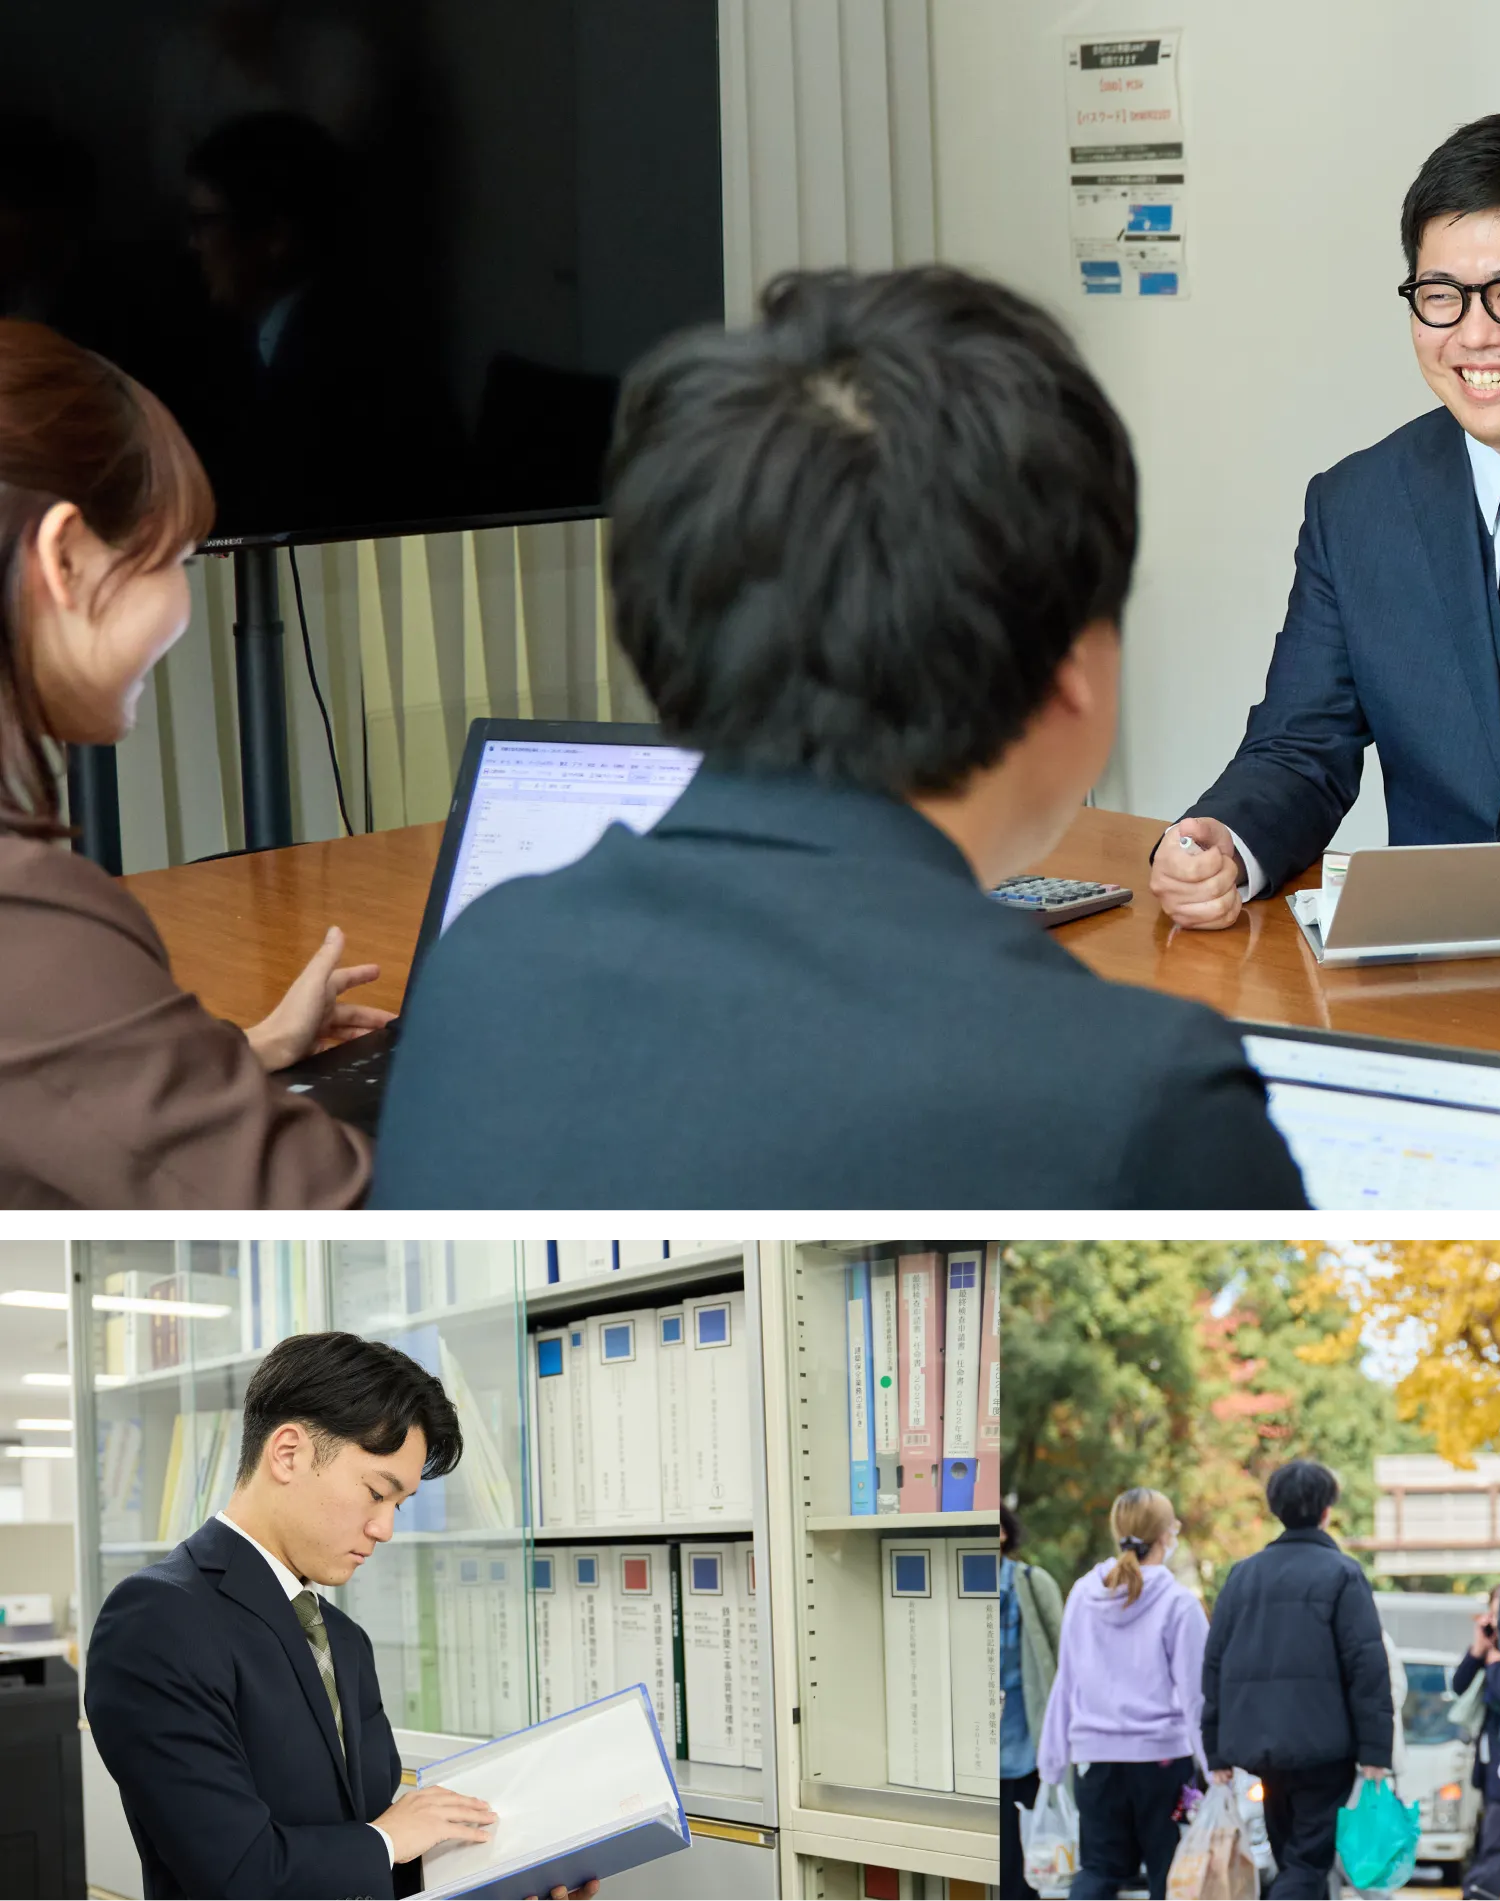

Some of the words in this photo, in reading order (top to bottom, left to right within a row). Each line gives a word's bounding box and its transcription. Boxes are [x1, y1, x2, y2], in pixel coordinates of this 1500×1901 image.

[956, 1289, 967, 1386] 最終検査申請書・任命書
